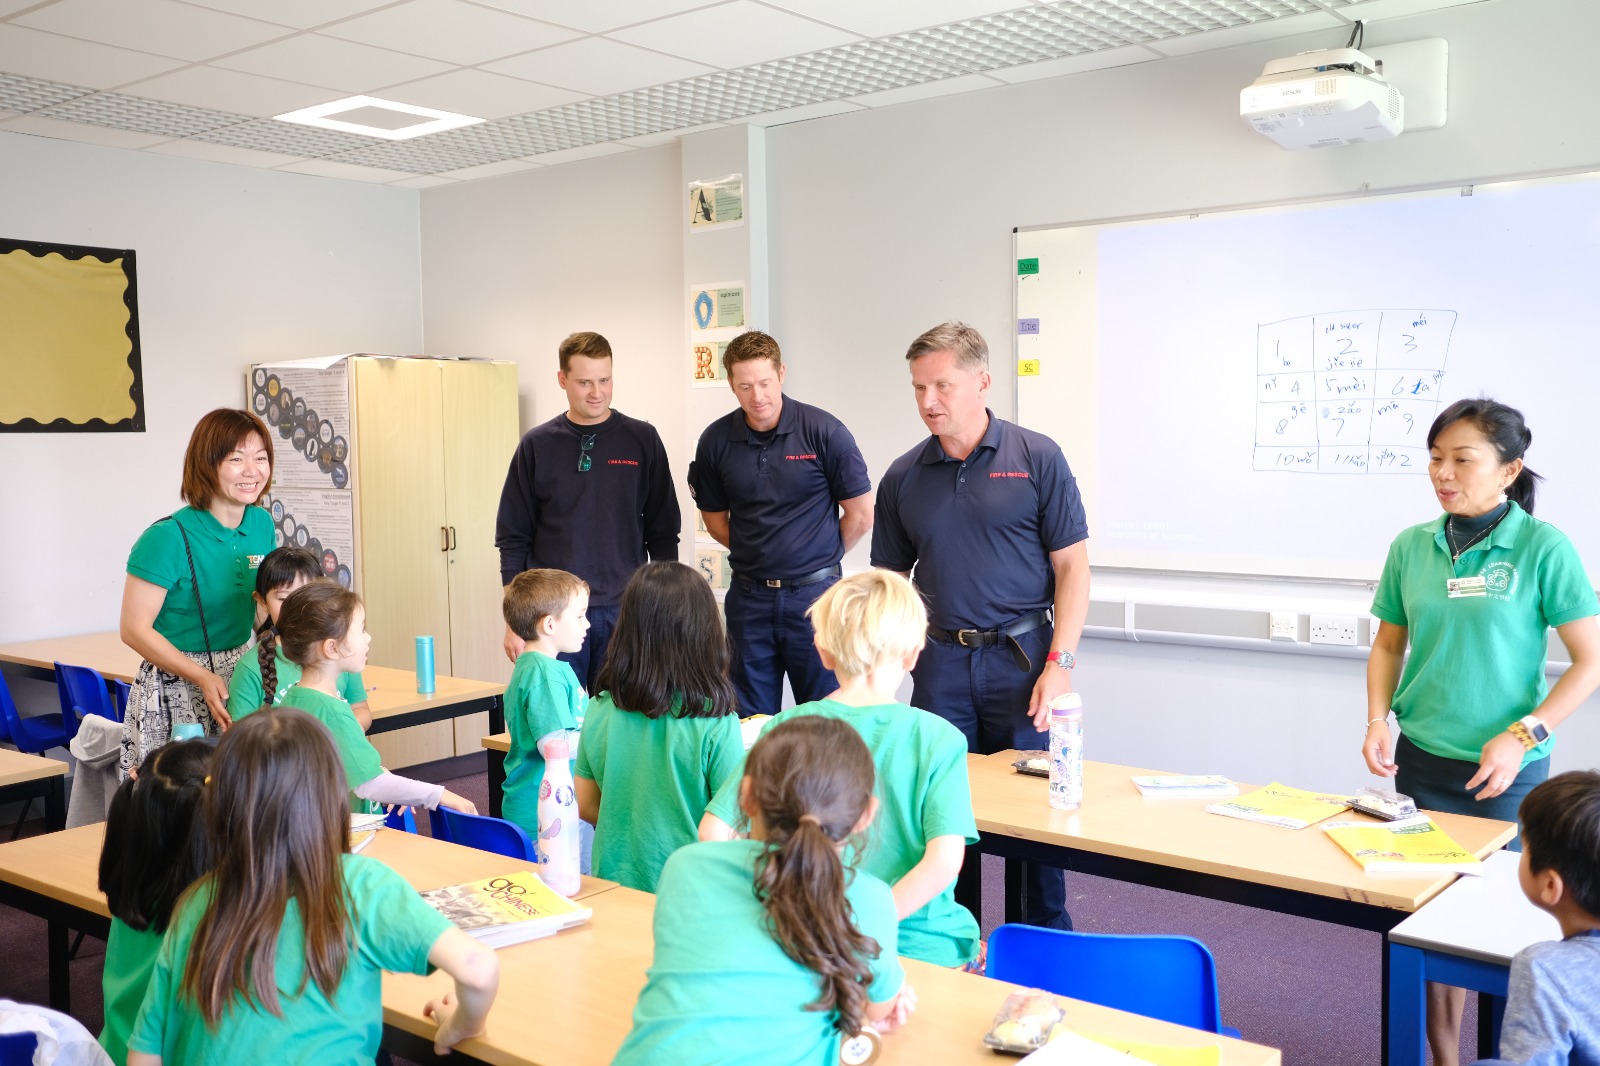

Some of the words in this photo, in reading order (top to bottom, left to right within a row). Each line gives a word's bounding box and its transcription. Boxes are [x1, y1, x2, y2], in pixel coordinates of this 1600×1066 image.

[1283, 89, 1301, 97] EPSON
[1019, 261, 1037, 271] Date
[1020, 321, 1037, 331] Title
[1336, 338, 1360, 356] 2
[1402, 334, 1418, 353] 3
[694, 346, 715, 380] R
[1024, 363, 1034, 372] SC
[1290, 381, 1301, 396] 4
[1275, 418, 1289, 435] 8
[1331, 417, 1345, 438] 7
[490, 891, 540, 916] CHINESE
